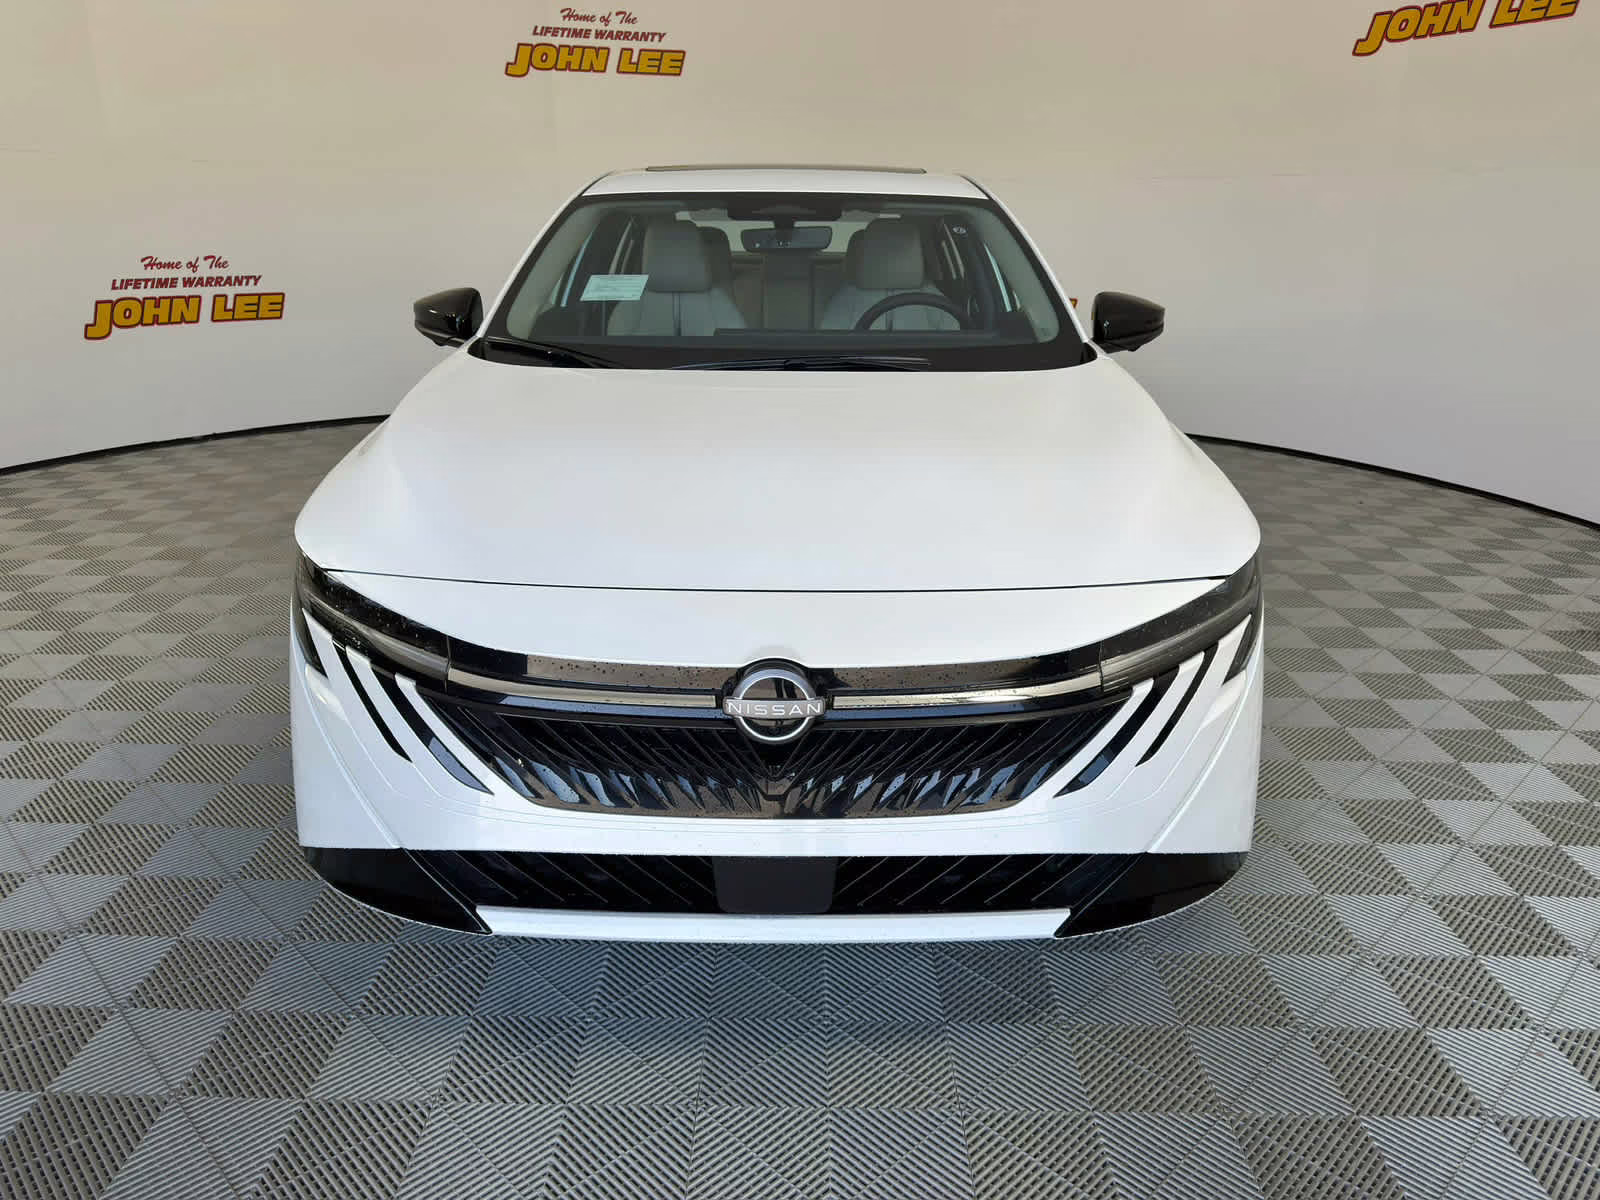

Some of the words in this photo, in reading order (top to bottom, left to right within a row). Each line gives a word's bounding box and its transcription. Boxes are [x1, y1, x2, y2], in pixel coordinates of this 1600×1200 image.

[560, 8, 596, 23] Home
[599, 12, 612, 26] of
[616, 11, 638, 25] The
[532, 25, 592, 39] LIFETIME
[594, 29, 667, 42] WARRANTY
[1352, 0, 1485, 56] JOHN
[505, 42, 610, 77] JOHN
[616, 47, 686, 76] LEE
[140, 255, 183, 270] Home
[186, 257, 199, 272] of
[203, 255, 229, 269] The
[111, 277, 178, 290] LIFETIME
[182, 275, 262, 288] WARRANTY
[84, 295, 201, 340] JOHN
[211, 292, 285, 322] LEE
[726, 702, 821, 715] NISSAN
